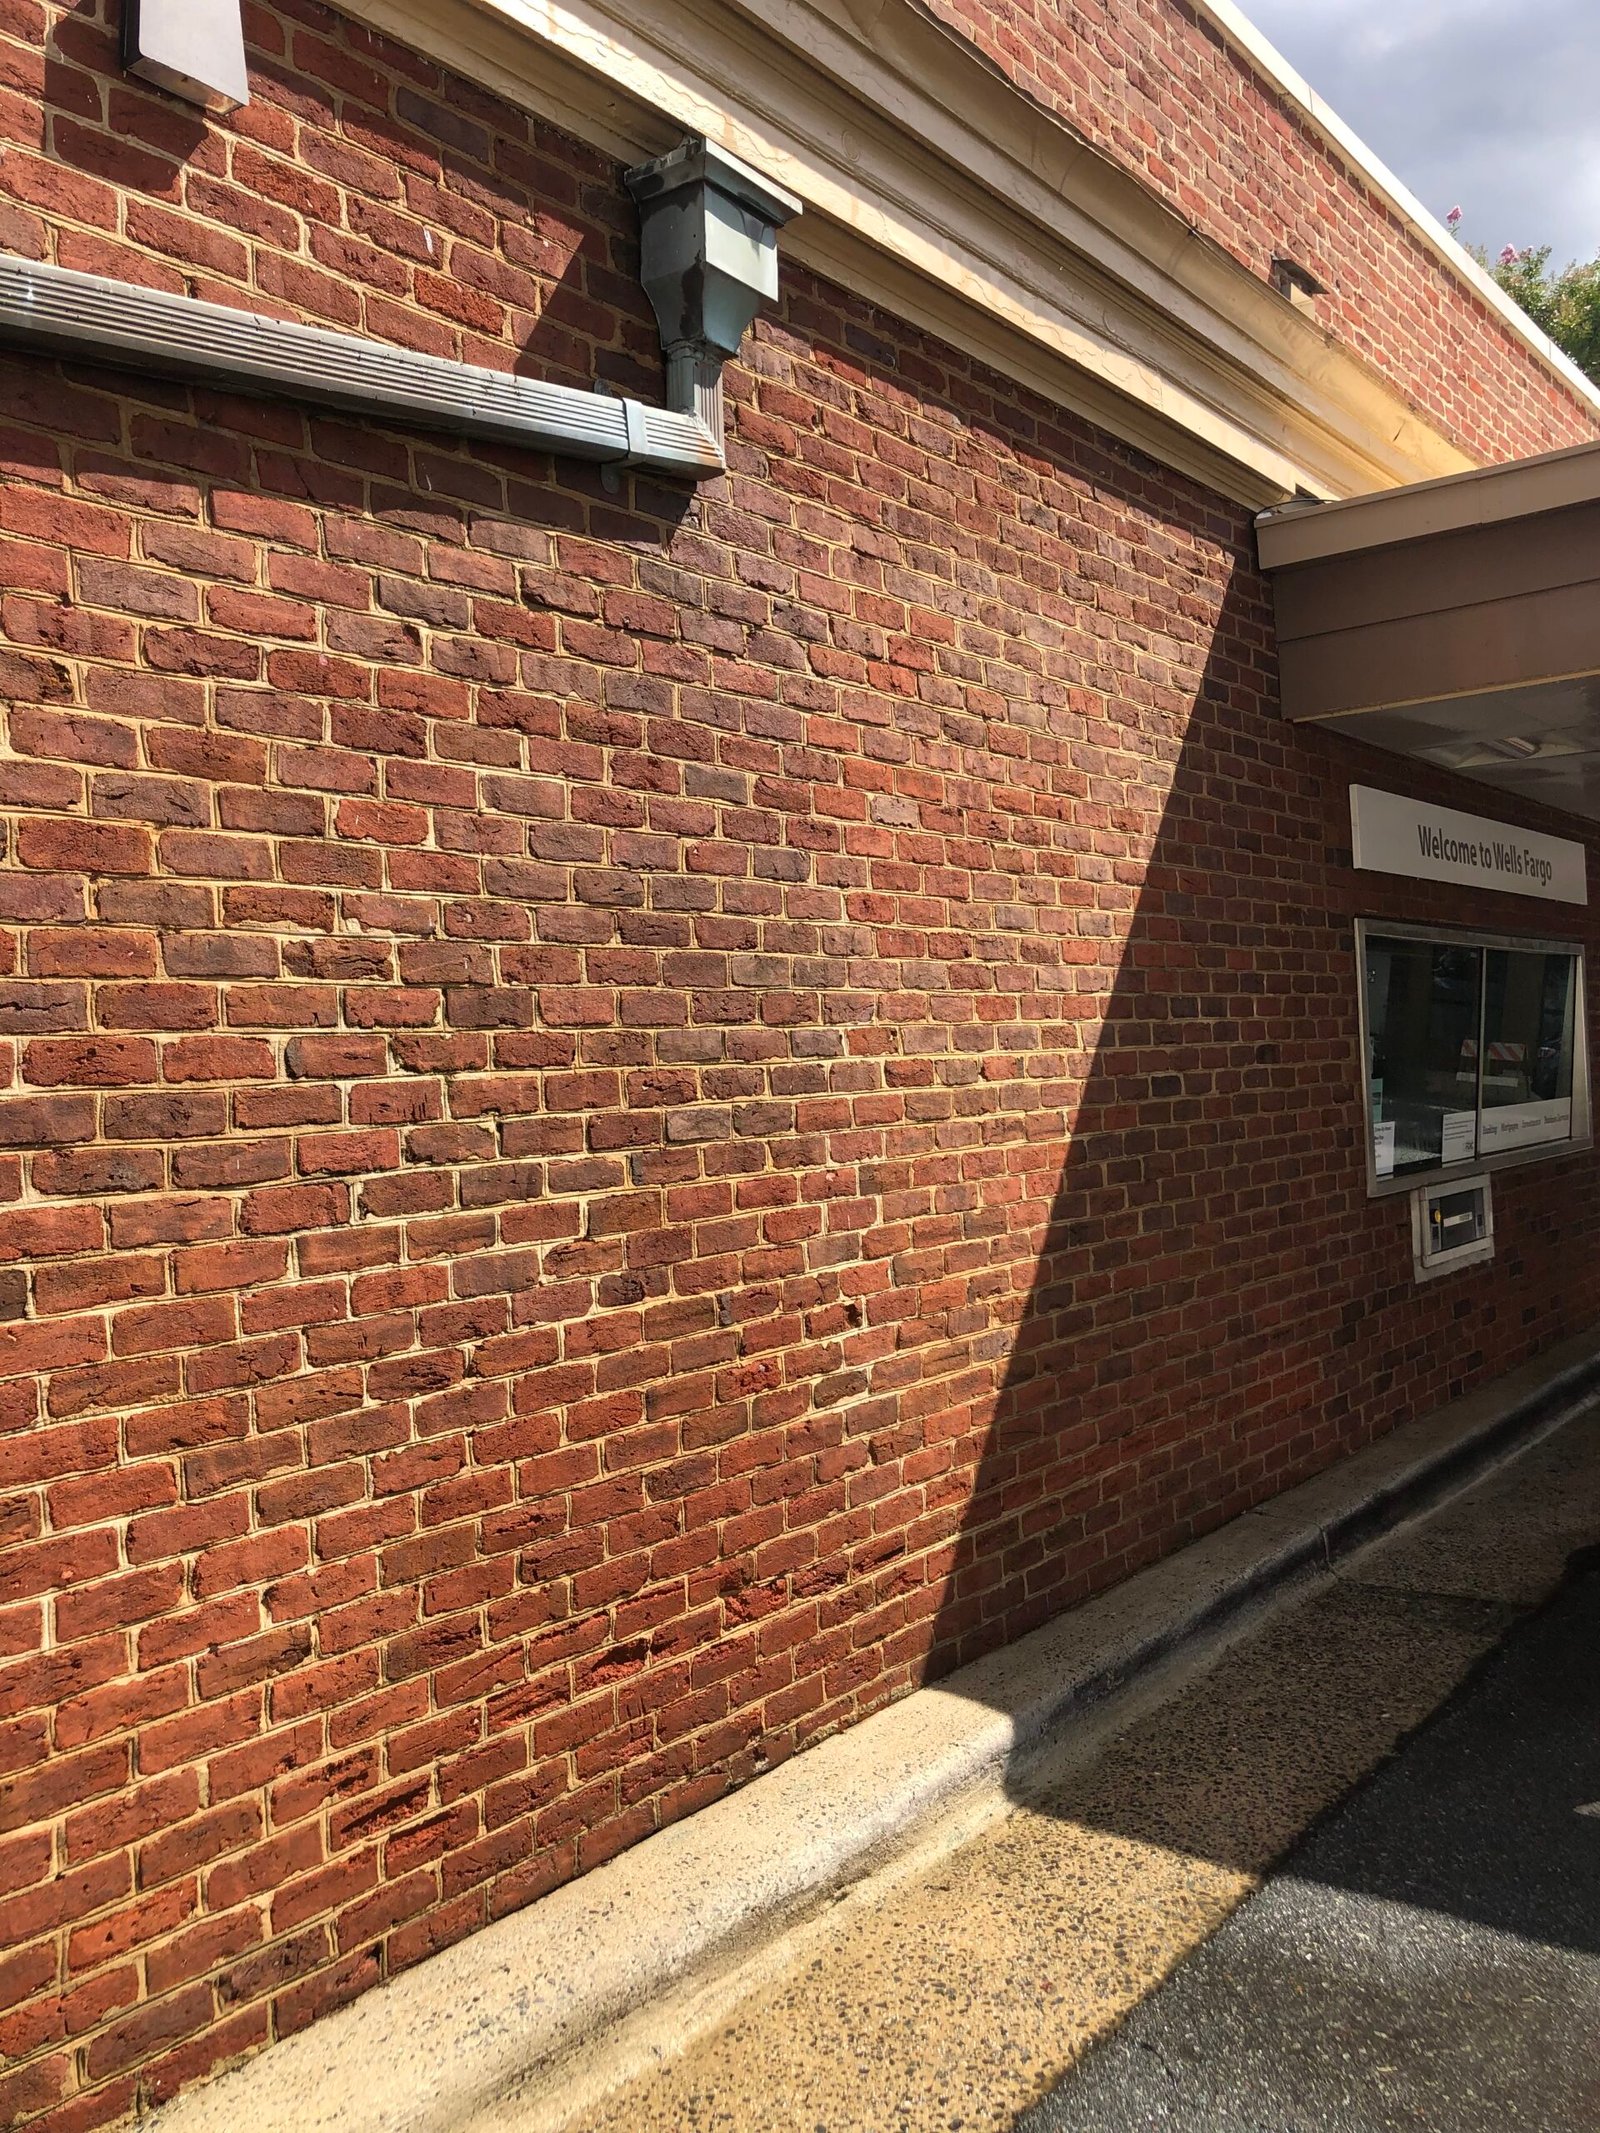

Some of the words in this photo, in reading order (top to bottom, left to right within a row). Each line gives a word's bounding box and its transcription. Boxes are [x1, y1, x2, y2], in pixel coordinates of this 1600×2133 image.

[1417, 824, 1477, 866] Welcome
[1479, 842, 1491, 869] to
[1493, 842, 1522, 875] Wells
[1524, 849, 1552, 886] Fargo
